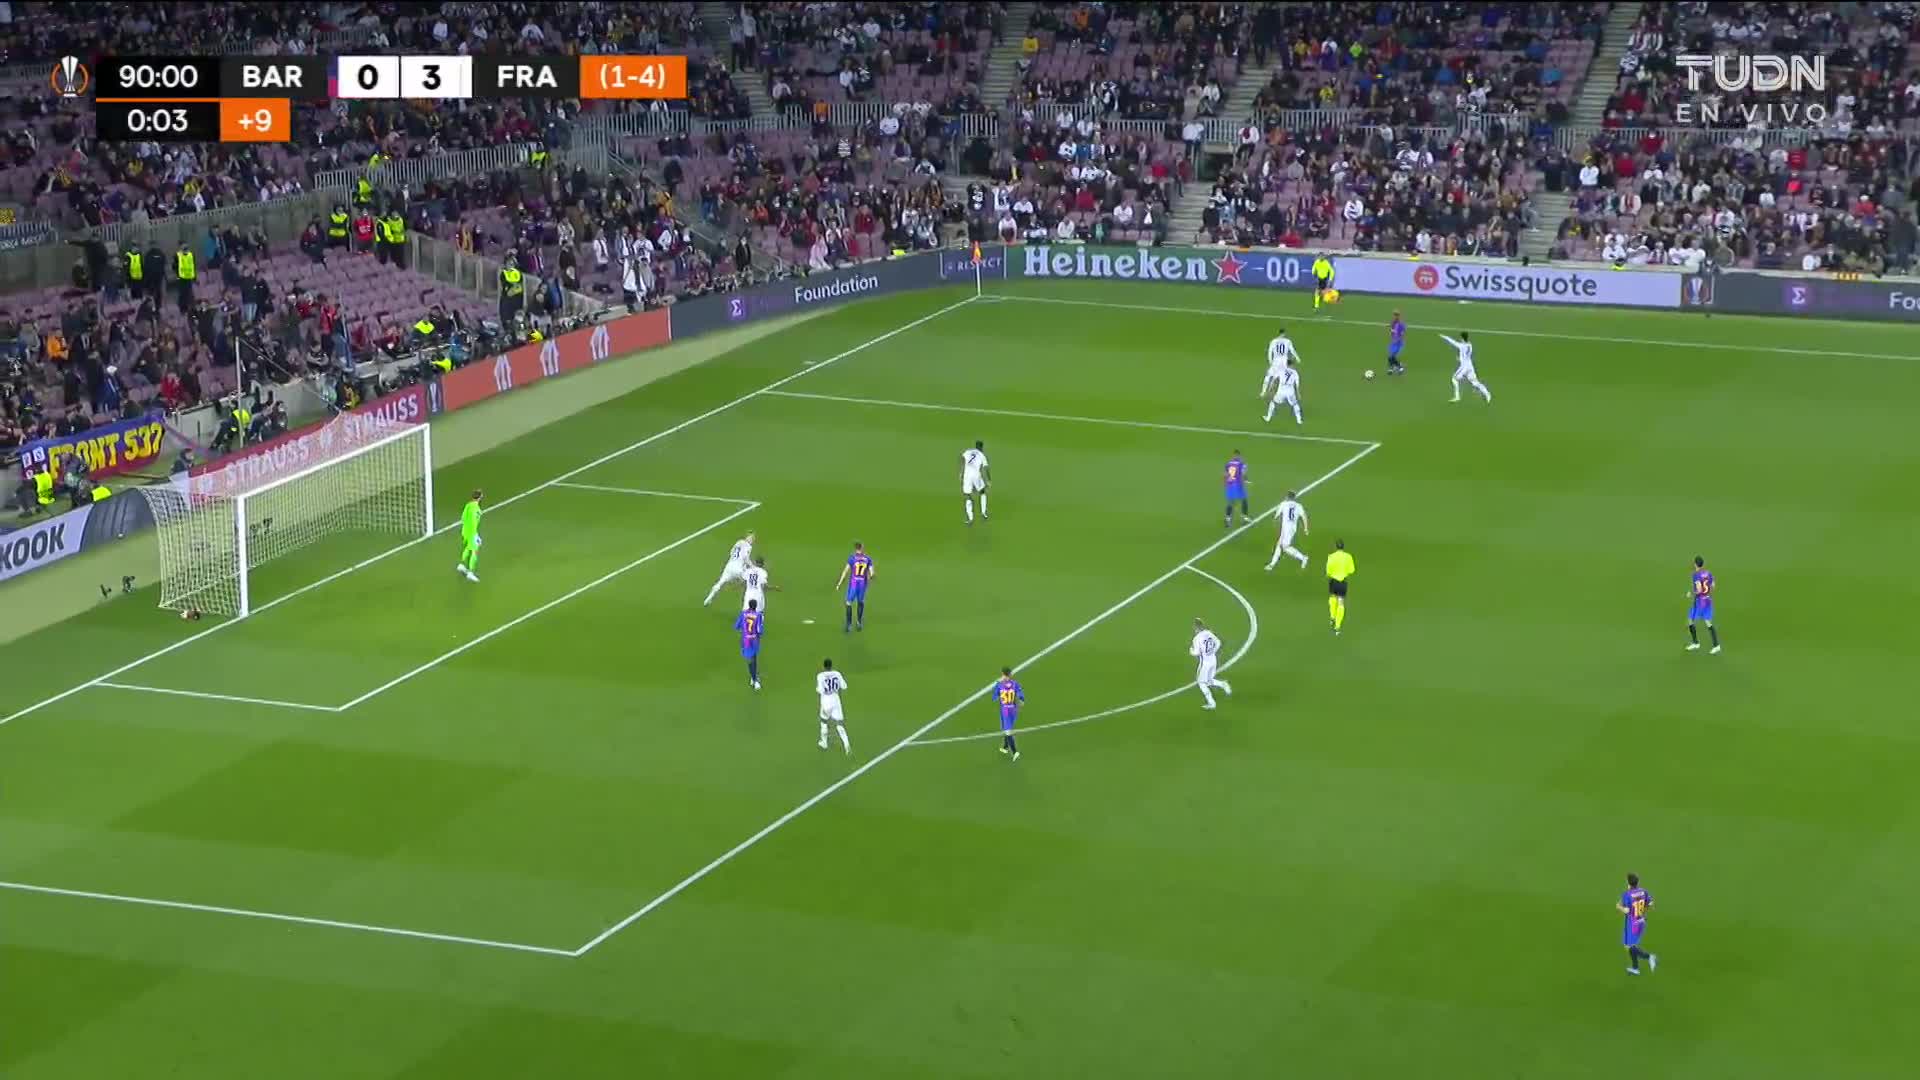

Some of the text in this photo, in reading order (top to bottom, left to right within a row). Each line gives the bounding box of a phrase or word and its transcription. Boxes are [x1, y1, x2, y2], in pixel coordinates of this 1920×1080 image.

[957, 257, 1002, 271] RESECT
[1024, 247, 1299, 282] Heineken 0.0
[795, 273, 878, 303] Foundation
[1445, 265, 1597, 300] Swissquote
[1276, 343, 1285, 355] 10
[344, 393, 418, 441] STRAUSS
[225, 434, 310, 487] STRAUSS
[855, 562, 868, 576] 17
[746, 617, 754, 632] 7
[823, 677, 839, 694] 36
